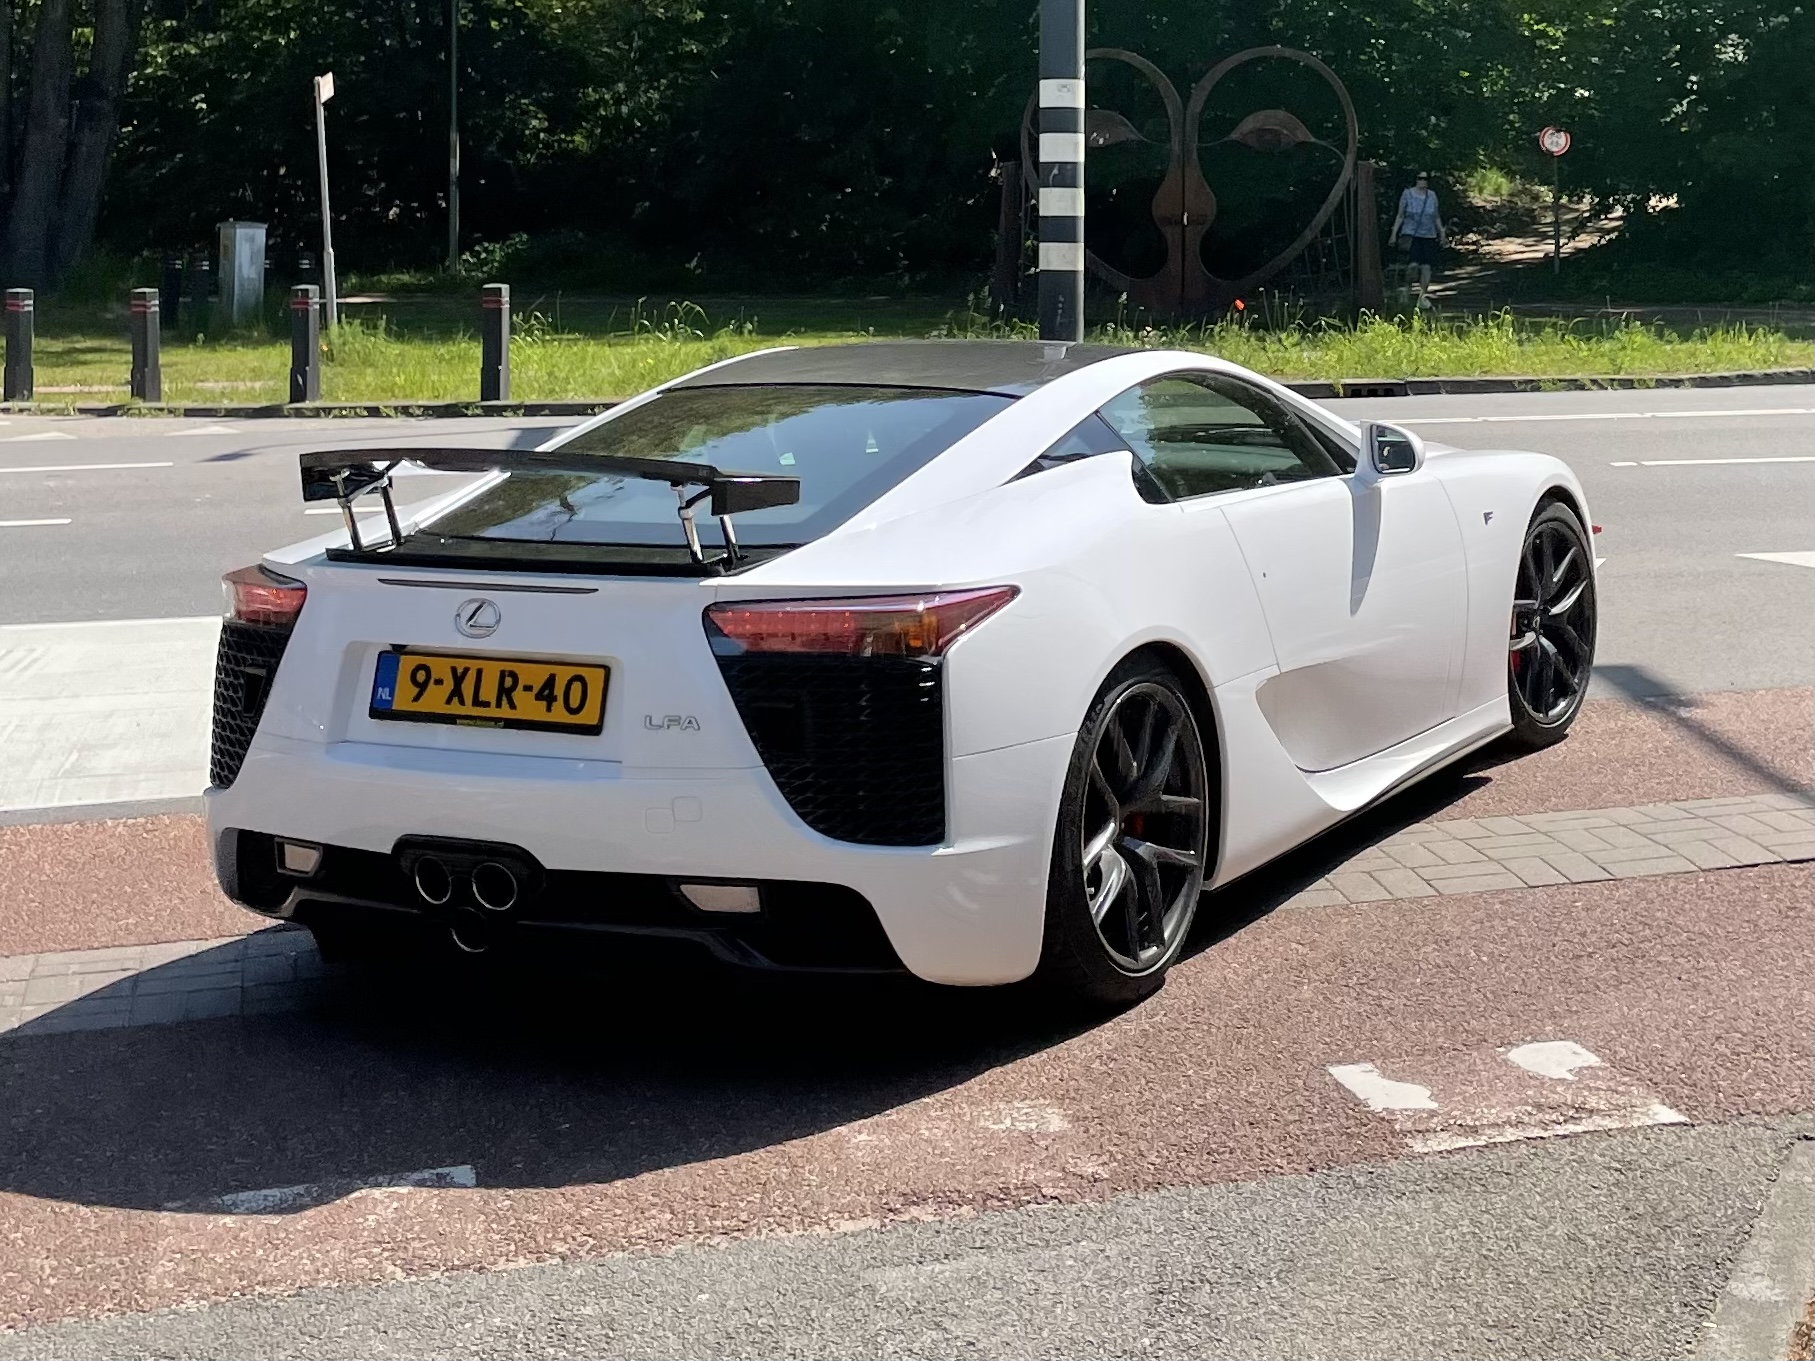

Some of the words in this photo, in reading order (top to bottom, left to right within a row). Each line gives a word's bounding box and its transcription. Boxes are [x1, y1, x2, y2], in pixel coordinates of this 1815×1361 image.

[377, 687, 391, 700] NL
[410, 663, 588, 715] 9-XLR-40
[644, 715, 700, 731] LFA
